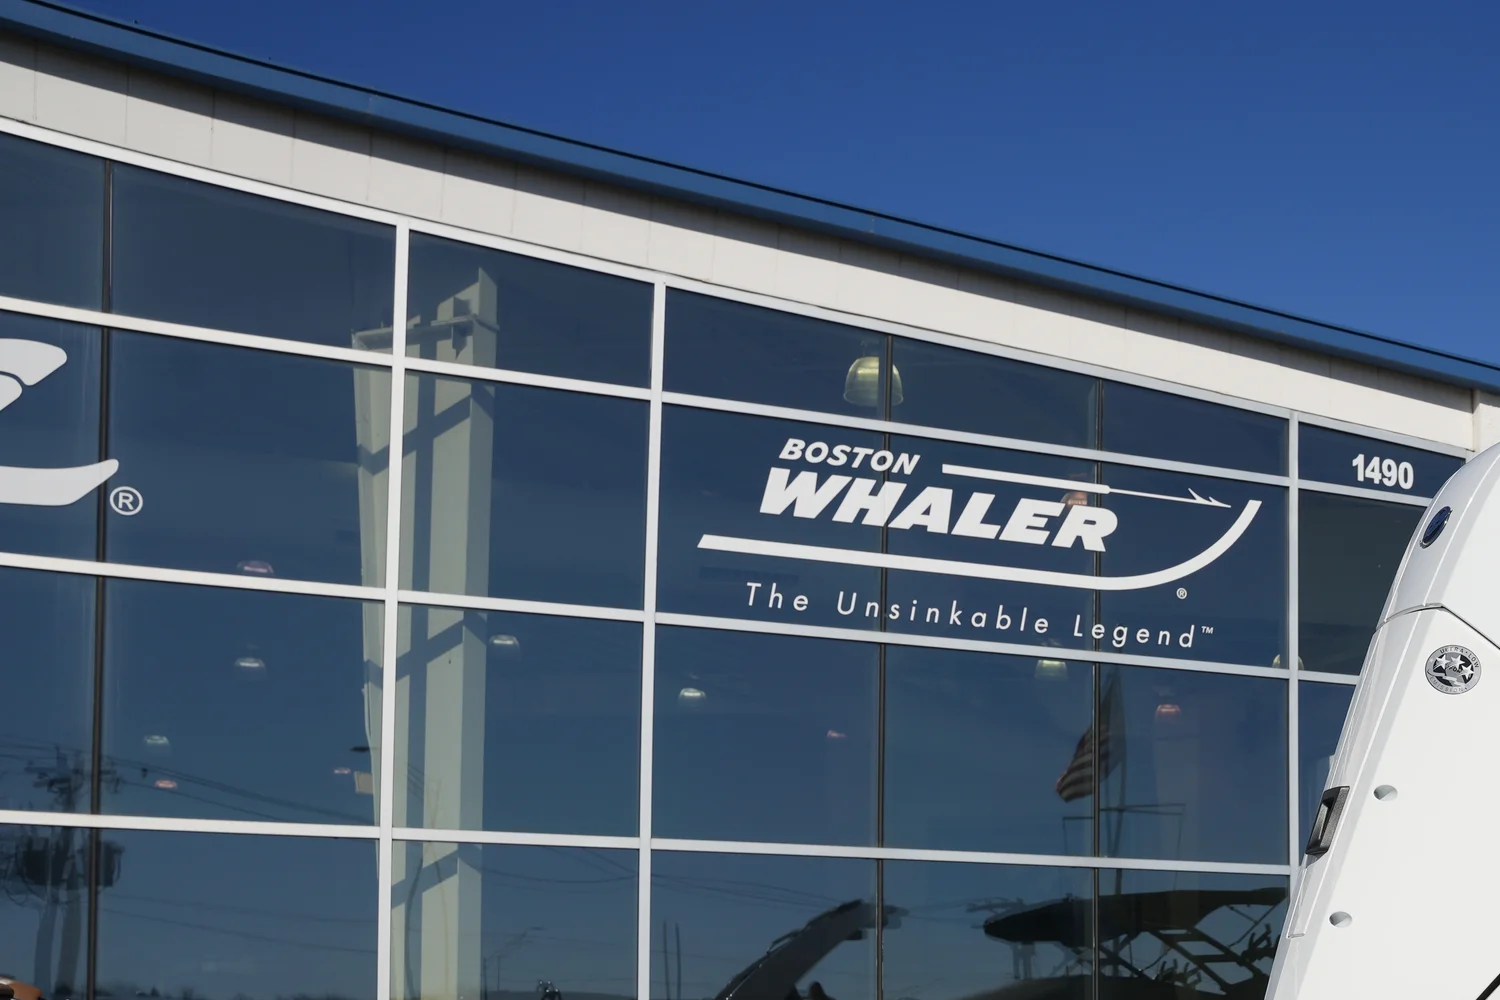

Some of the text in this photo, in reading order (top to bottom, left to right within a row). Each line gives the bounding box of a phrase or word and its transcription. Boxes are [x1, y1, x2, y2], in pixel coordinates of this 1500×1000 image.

[778, 438, 921, 475] BOSTON
[1352, 453, 1414, 490] 1490
[759, 467, 1119, 552] WHALER
[746, 582, 809, 611] The
[836, 591, 1049, 634] Unsinkable
